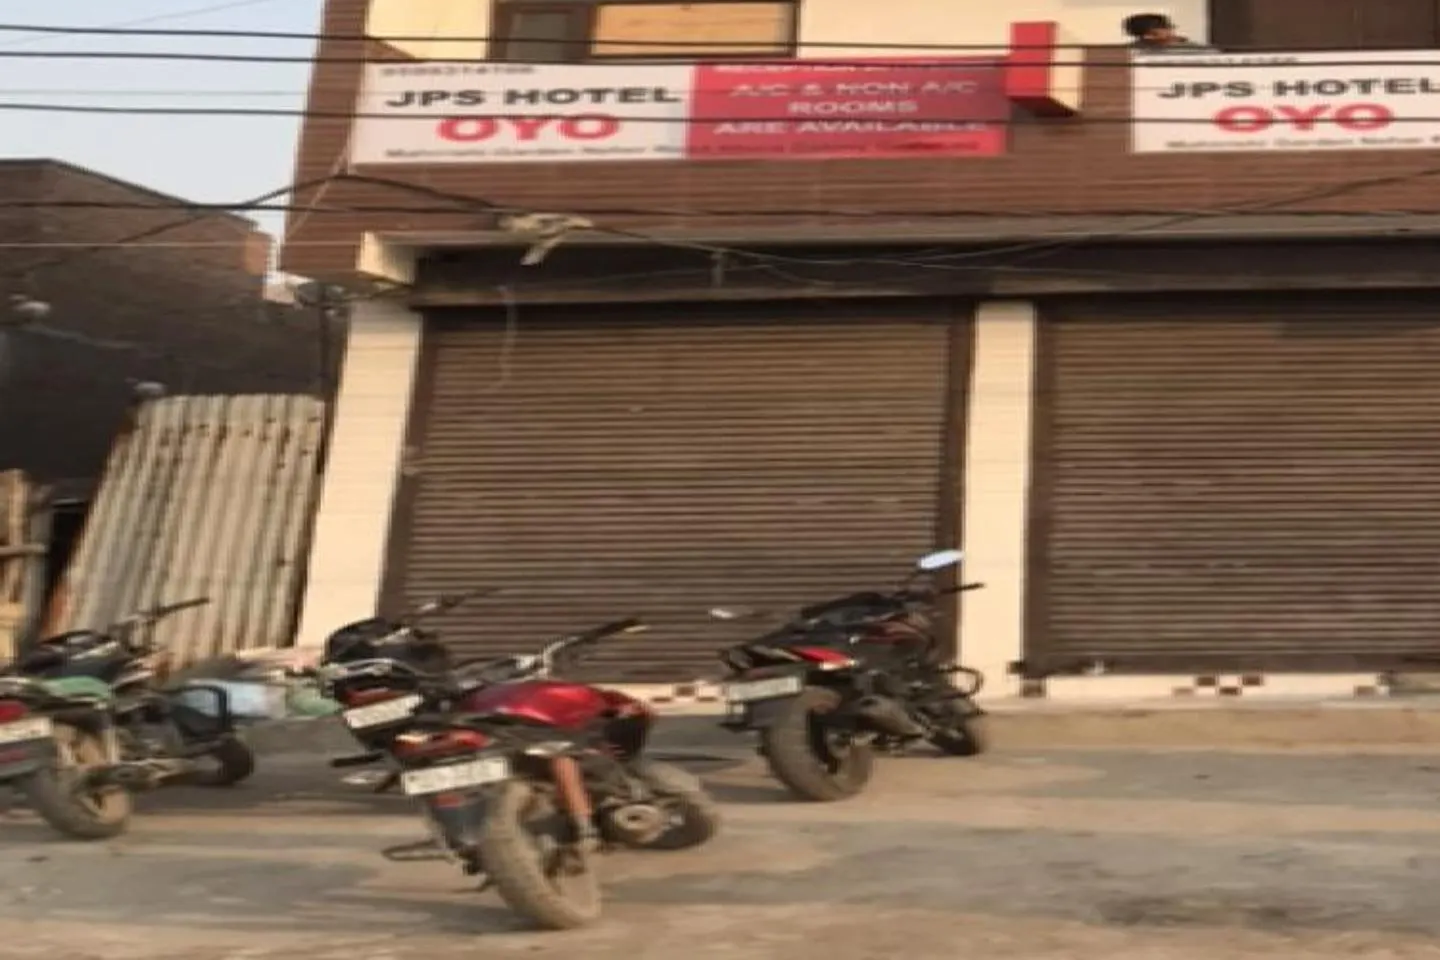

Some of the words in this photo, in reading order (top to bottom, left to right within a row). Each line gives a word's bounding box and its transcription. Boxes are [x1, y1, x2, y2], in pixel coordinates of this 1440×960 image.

[385, 89, 486, 107] JPS
[503, 86, 682, 105] HOTEL
[836, 81, 910, 95] NON
[1157, 80, 1256, 99] JPS
[788, 100, 919, 114] ROOMS
[435, 113, 620, 142] OYO
[1213, 103, 1395, 133] OYO
[713, 120, 788, 136] ARE
